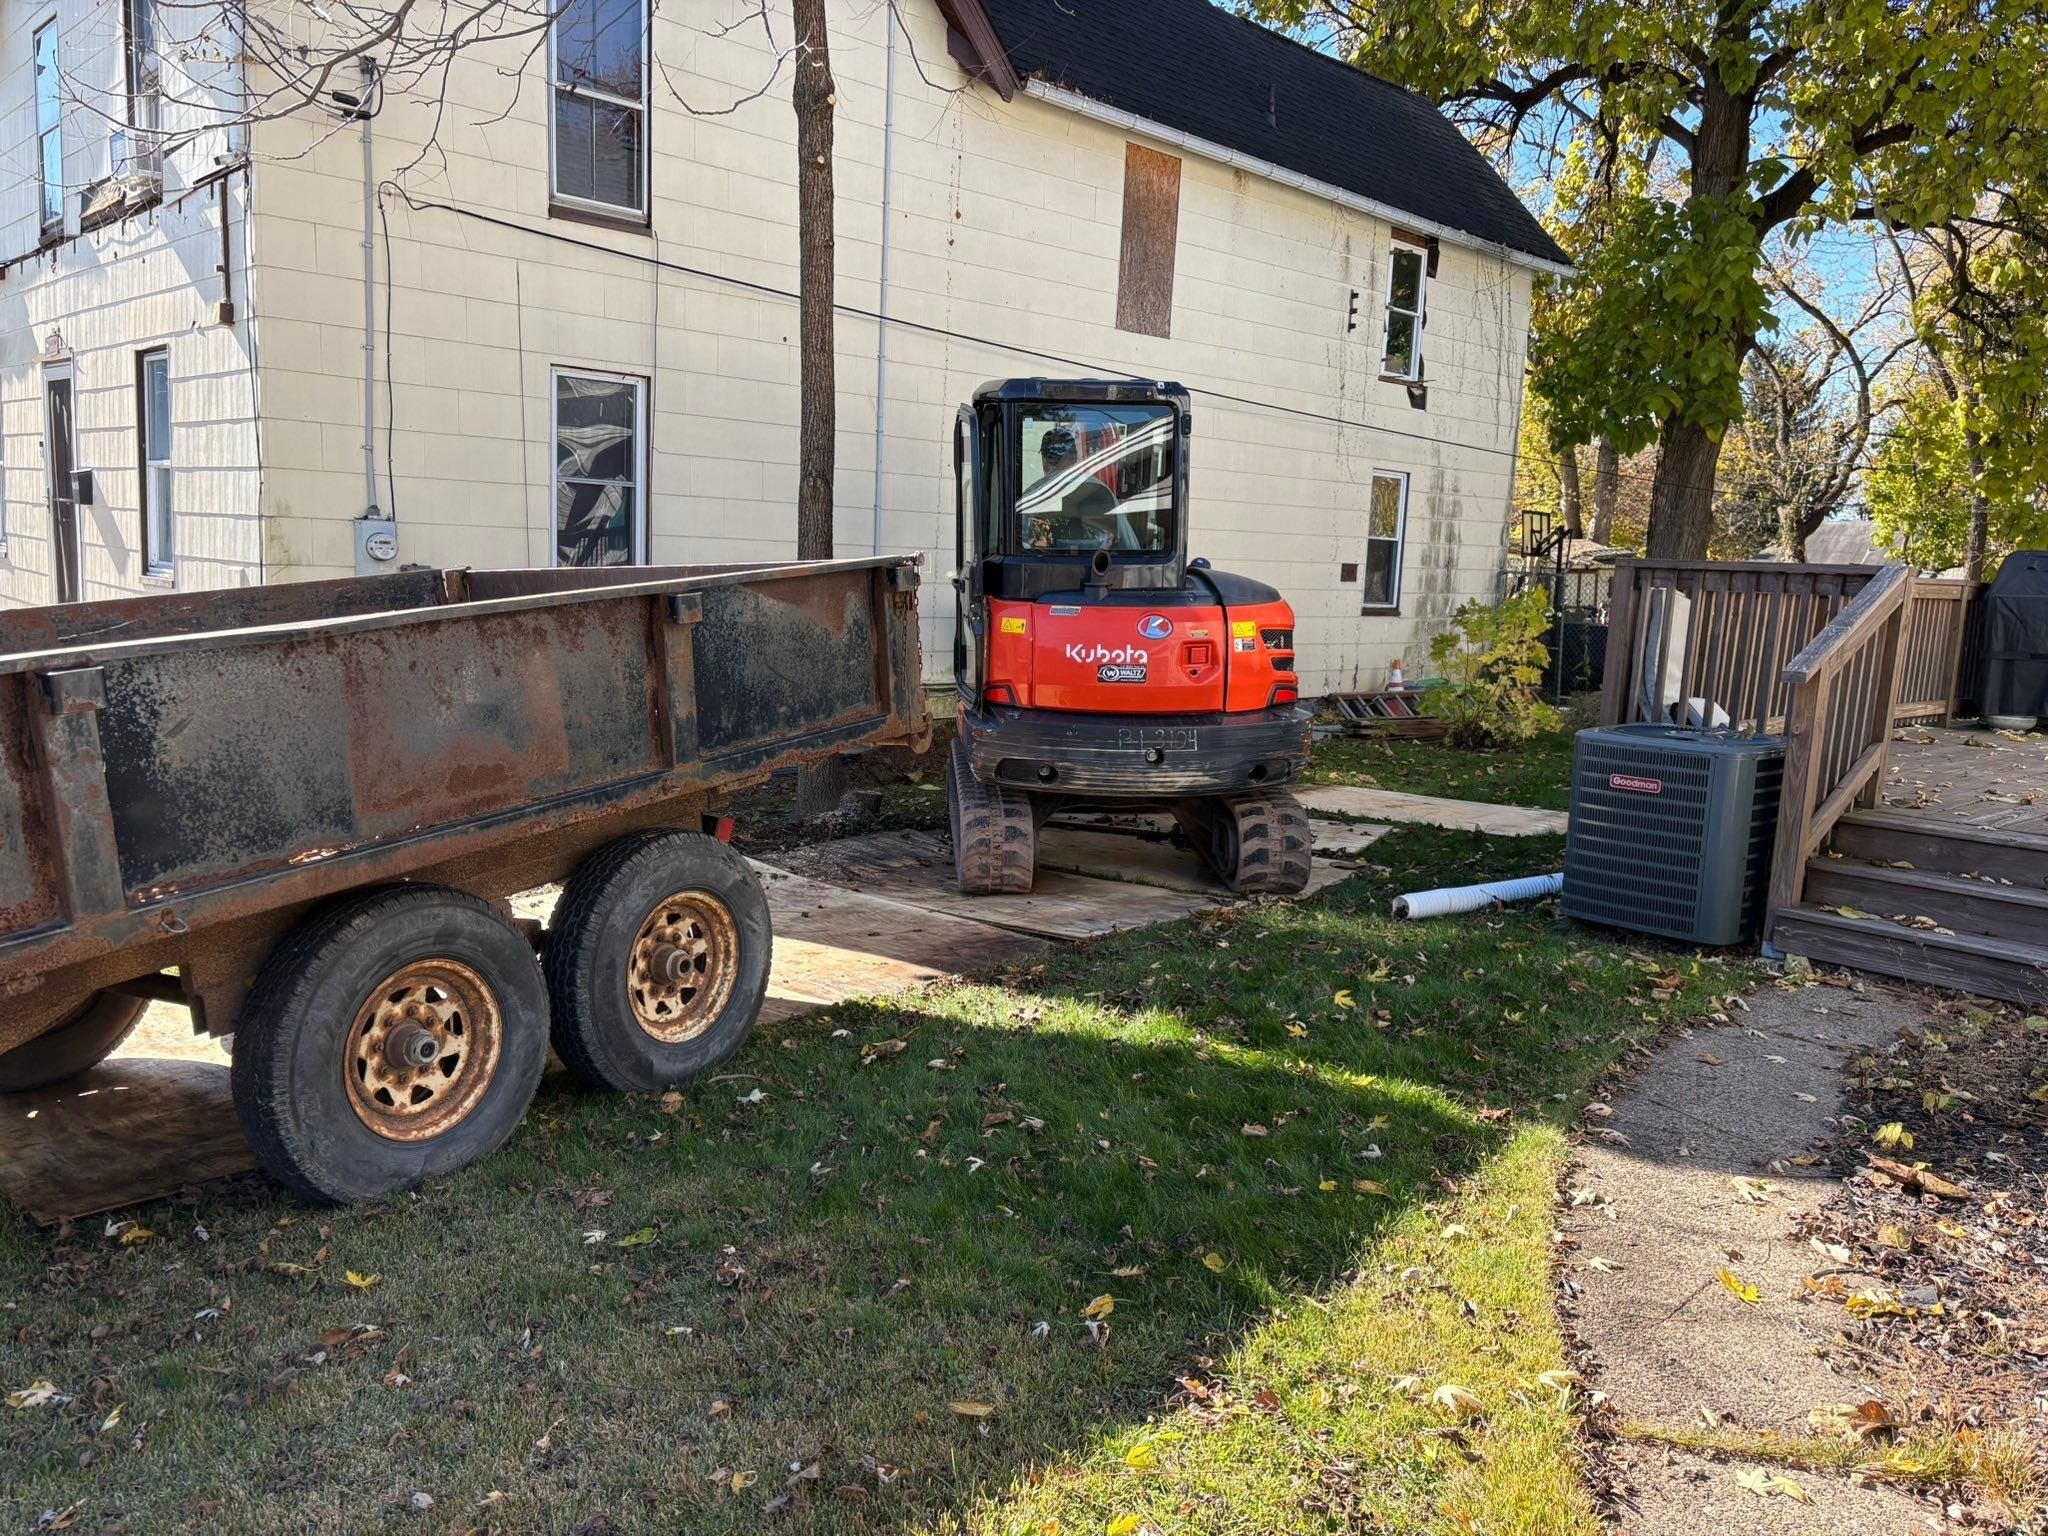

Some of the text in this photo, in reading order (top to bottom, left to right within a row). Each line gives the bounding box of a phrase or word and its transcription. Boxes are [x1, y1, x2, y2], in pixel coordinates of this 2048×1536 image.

[1065, 643, 1149, 664] Kubota
[1120, 669, 1142, 677] WALTZ
[1613, 776, 1658, 790] Goodman
